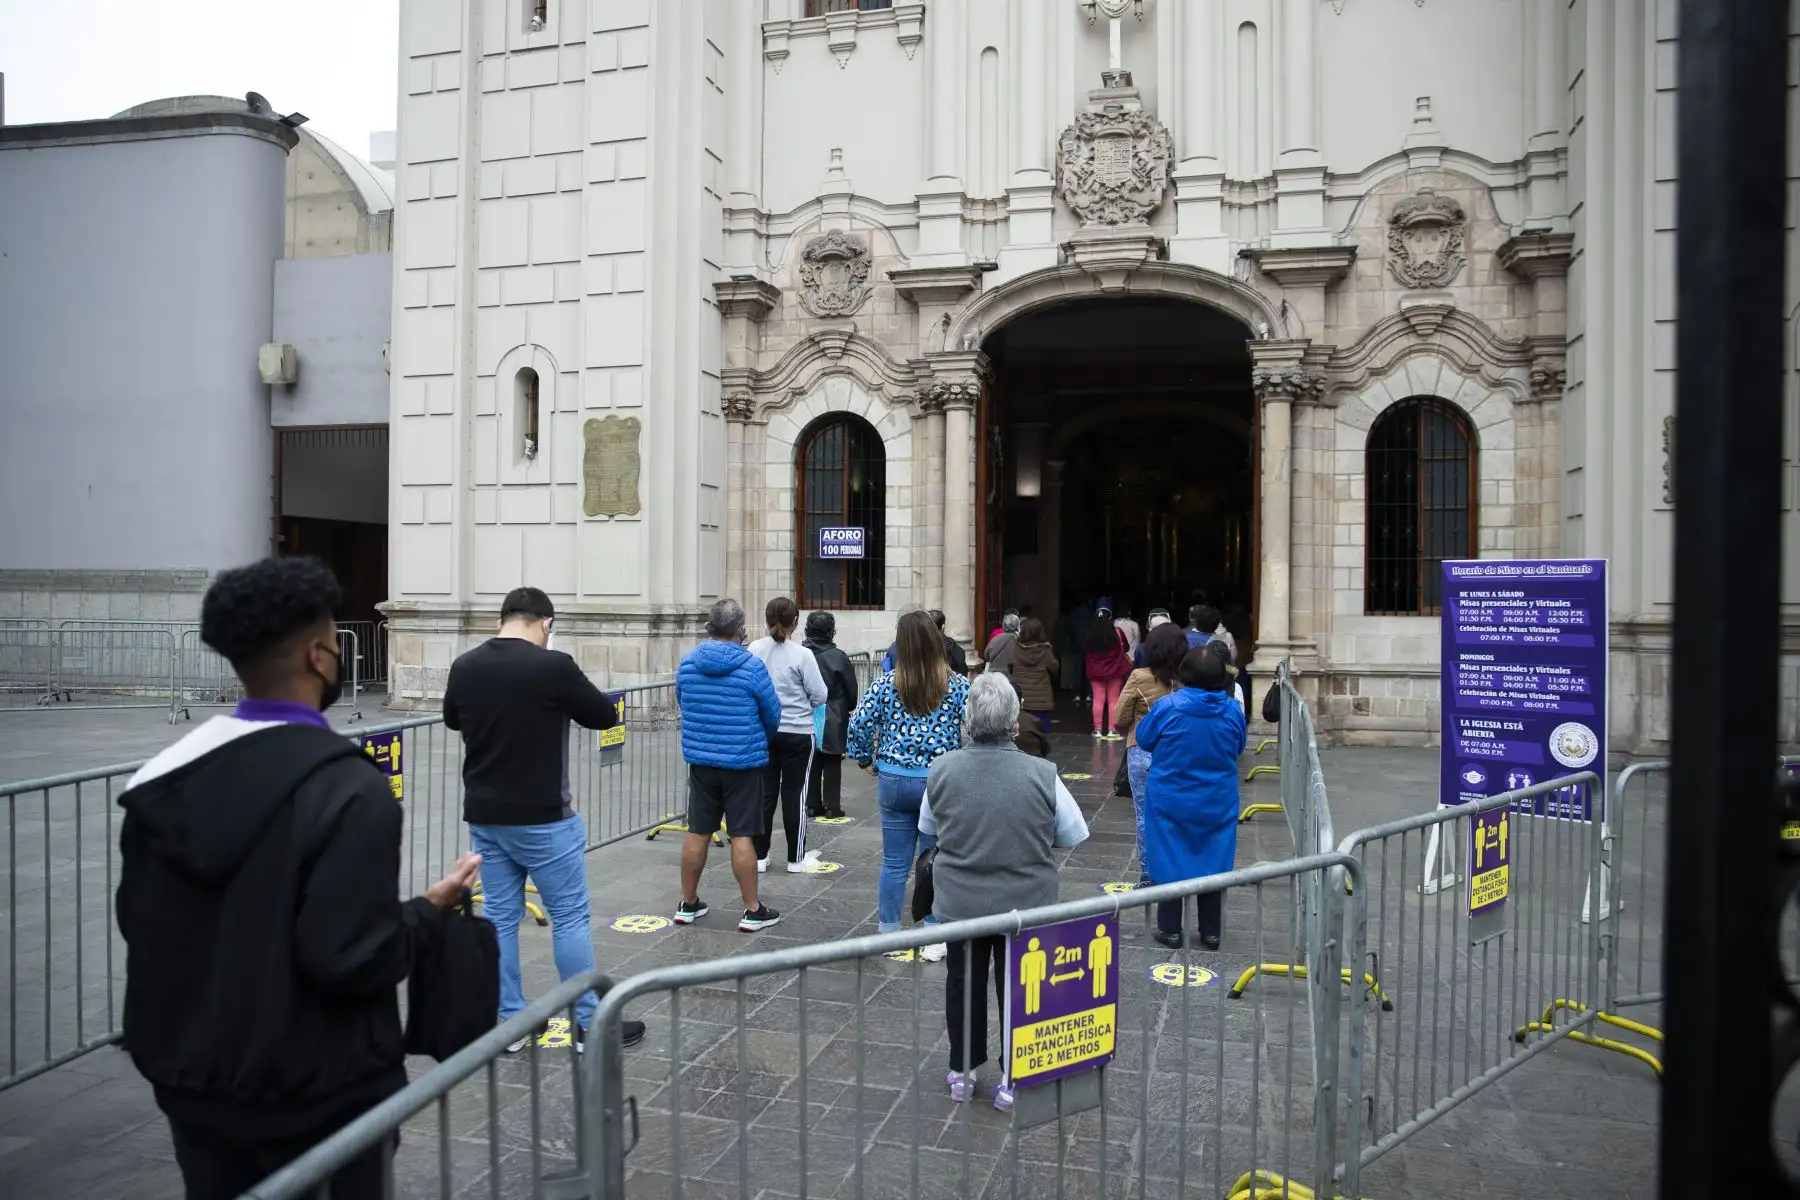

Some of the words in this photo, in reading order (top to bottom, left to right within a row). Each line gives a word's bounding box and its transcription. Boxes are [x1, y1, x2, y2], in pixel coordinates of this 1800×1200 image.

[823, 530, 862, 540] AFORO
[823, 545, 839, 555] 100
[1452, 566, 1483, 576] Horario
[1484, 566, 1497, 575] de
[1497, 565, 1522, 575] Misas
[1522, 567, 1535, 575] en
[1535, 565, 1546, 575] el
[1546, 564, 1593, 574] Santuario
[1497, 589, 1524, 598] SÁBADO
[1481, 600, 1528, 608] presenciales
[1529, 601, 1534, 609] y
[1528, 626, 1561, 634] Virtuales
[1460, 653, 1495, 661] DOMINGOS
[1459, 663, 1480, 671] Misas
[1481, 664, 1528, 673] presenciales
[1529, 666, 1534, 675] y
[1535, 665, 1571, 675] Virtuales
[1548, 676, 1569, 684] 11:00
[1570, 677, 1586, 685] A.M.
[1459, 688, 1498, 697] Celebración
[1508, 691, 1528, 699] Misas
[1528, 692, 1561, 701] Virtuales
[1480, 698, 1501, 706] 07:00
[1460, 719, 1470, 727] LA
[1471, 720, 1502, 729] IGLESIA
[1503, 721, 1524, 730] ESTÁ
[1462, 729, 1495, 738] ABIERTA
[1491, 742, 1507, 750] A.M.
[1488, 825, 1497, 837] 2m
[1479, 870, 1502, 884] MANTENER
[1472, 880, 1495, 897] DISTANCIA
[1477, 895, 1484, 904] DE
[1484, 892, 1488, 902] 2
[1487, 887, 1504, 900] METROS
[1054, 946, 1082, 965] 2m
[1034, 1014, 1095, 1040] MANTENER
[1016, 1032, 1075, 1060] DISTANCIA
[1029, 1056, 1044, 1070] DE
[1047, 1053, 1054, 1065] 2
[1057, 1040, 1101, 1063] METROS
